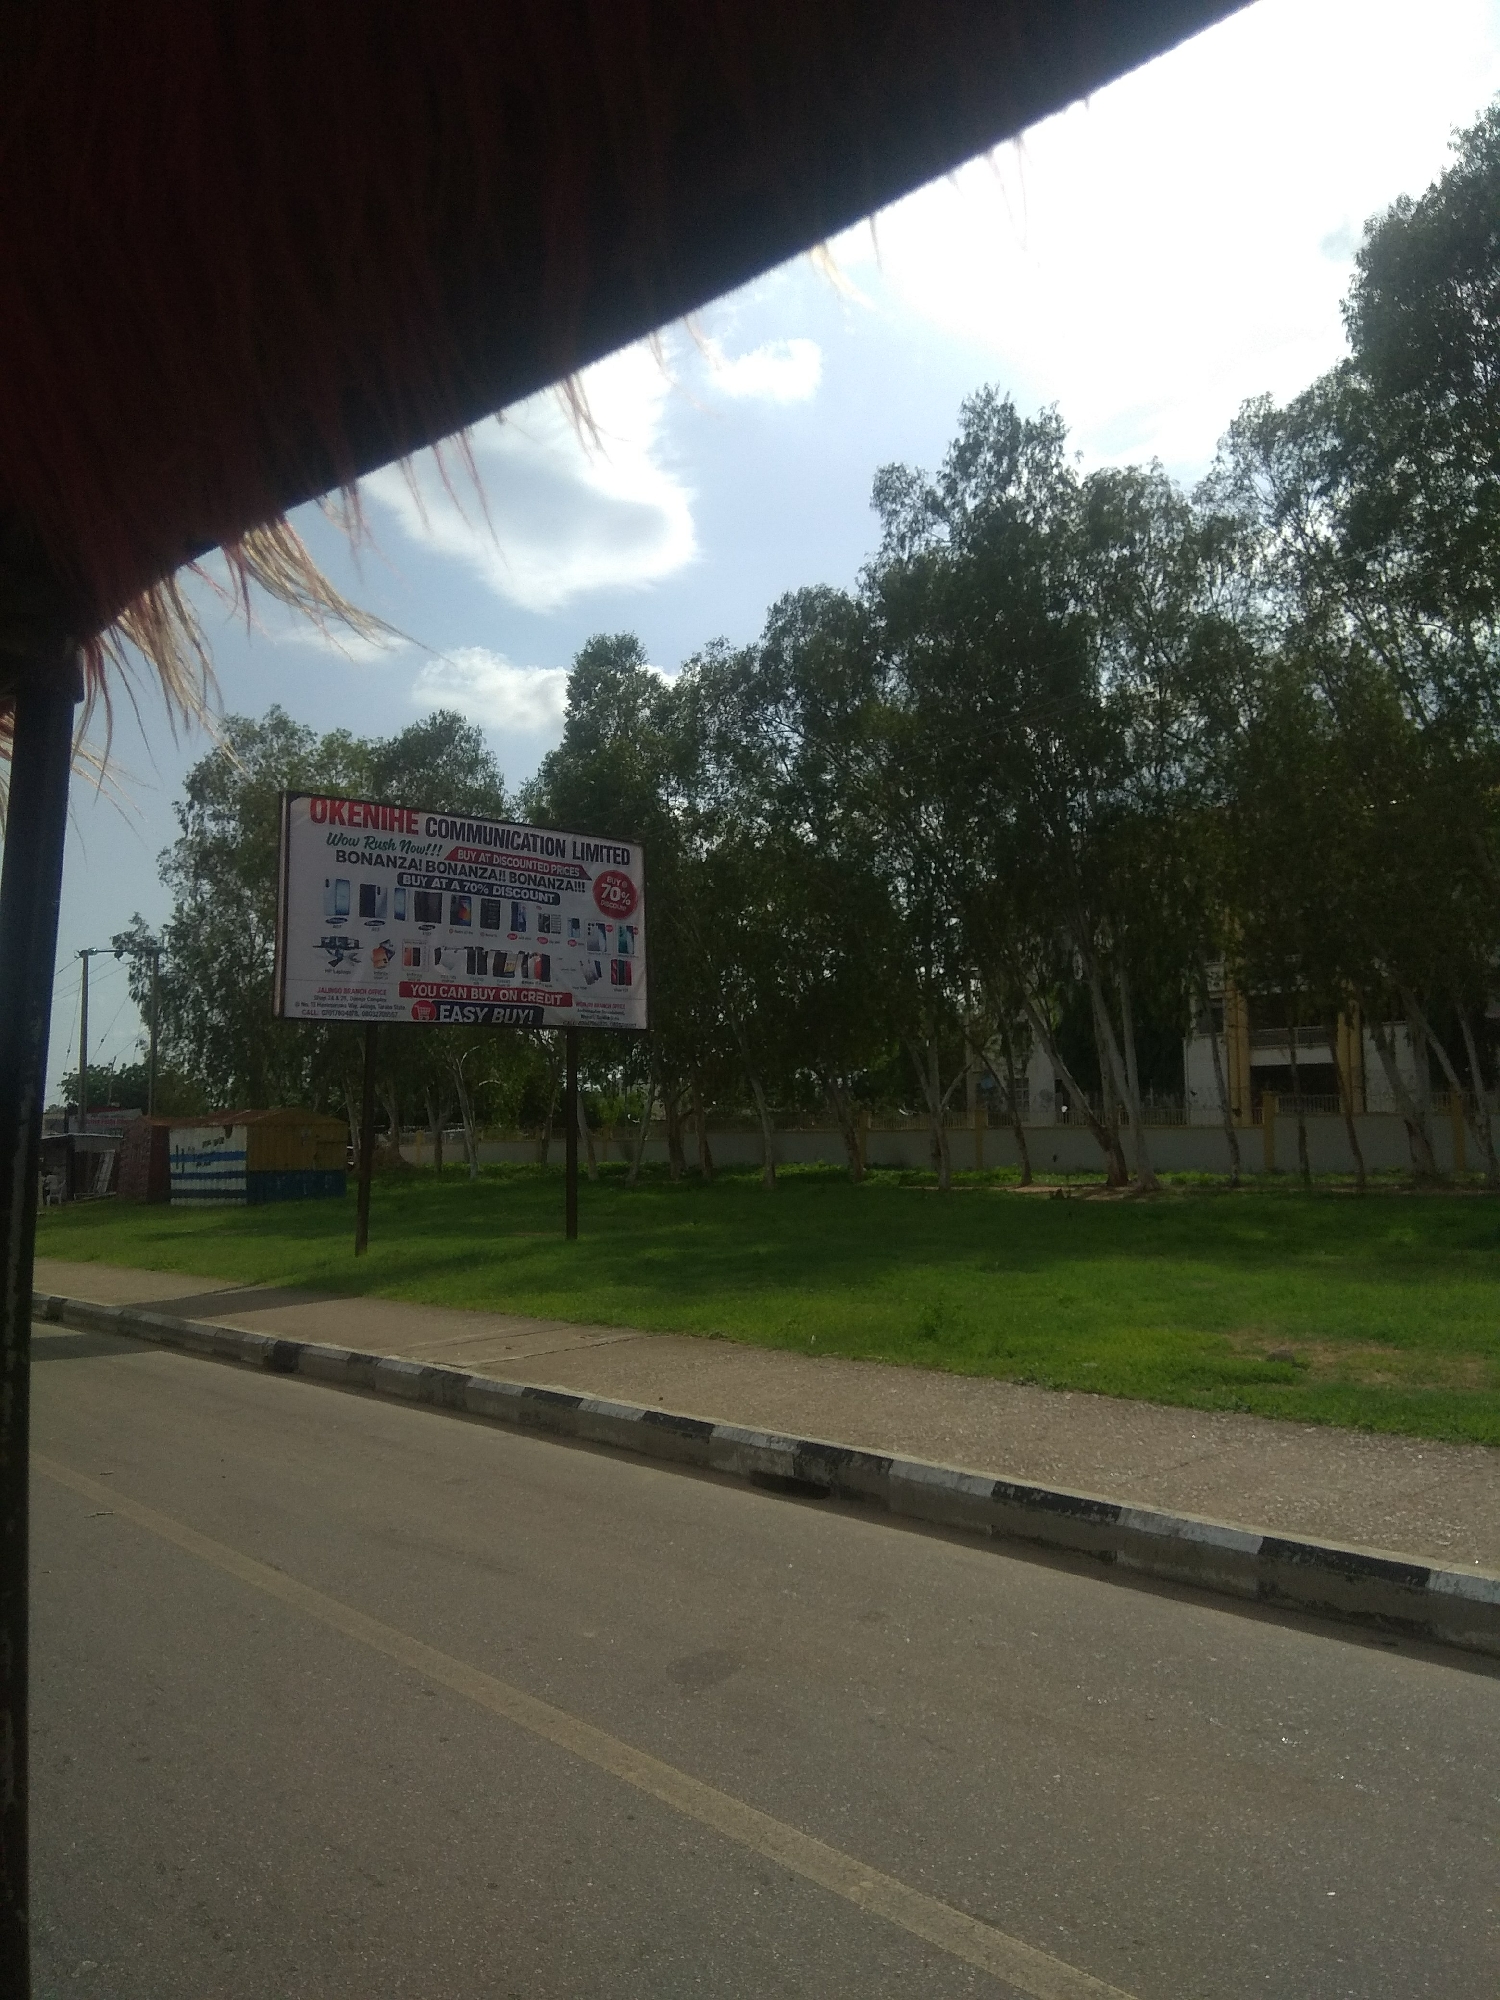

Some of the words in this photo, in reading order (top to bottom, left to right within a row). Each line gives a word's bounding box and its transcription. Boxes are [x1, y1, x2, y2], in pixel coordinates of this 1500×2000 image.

[310, 797, 420, 835] OKENIHE
[425, 816, 566, 859] COMMUNICATION
[572, 840, 631, 866] LIMITED
[326, 832, 360, 846] Wow
[364, 835, 397, 851] Rush
[399, 839, 443, 856] Now!!!
[336, 850, 422, 871] BONANZA!
[425, 860, 507, 882] BONANZA!!
[509, 872, 586, 893] BONANZA!!!
[458, 850, 476, 861] BUY
[478, 852, 490, 863] AT
[493, 854, 549, 873] DISCOUNTED
[551, 864, 580, 877] PRICES
[402, 874, 427, 886] BUY
[430, 877, 448, 888] AT
[450, 879, 461, 890] A
[463, 882, 489, 895] 70%
[492, 886, 555, 903] DISCOUNT
[606, 875, 621, 886] BUY
[601, 883, 631, 906] 70%
[410, 984, 438, 997] YOU
[442, 985, 467, 999] CAN
[470, 987, 496, 1000] BUY
[499, 989, 518, 1001] ON
[520, 990, 563, 1006] CREDIT
[439, 1003, 488, 1024] EASY
[491, 1007, 535, 1025] BUY!
